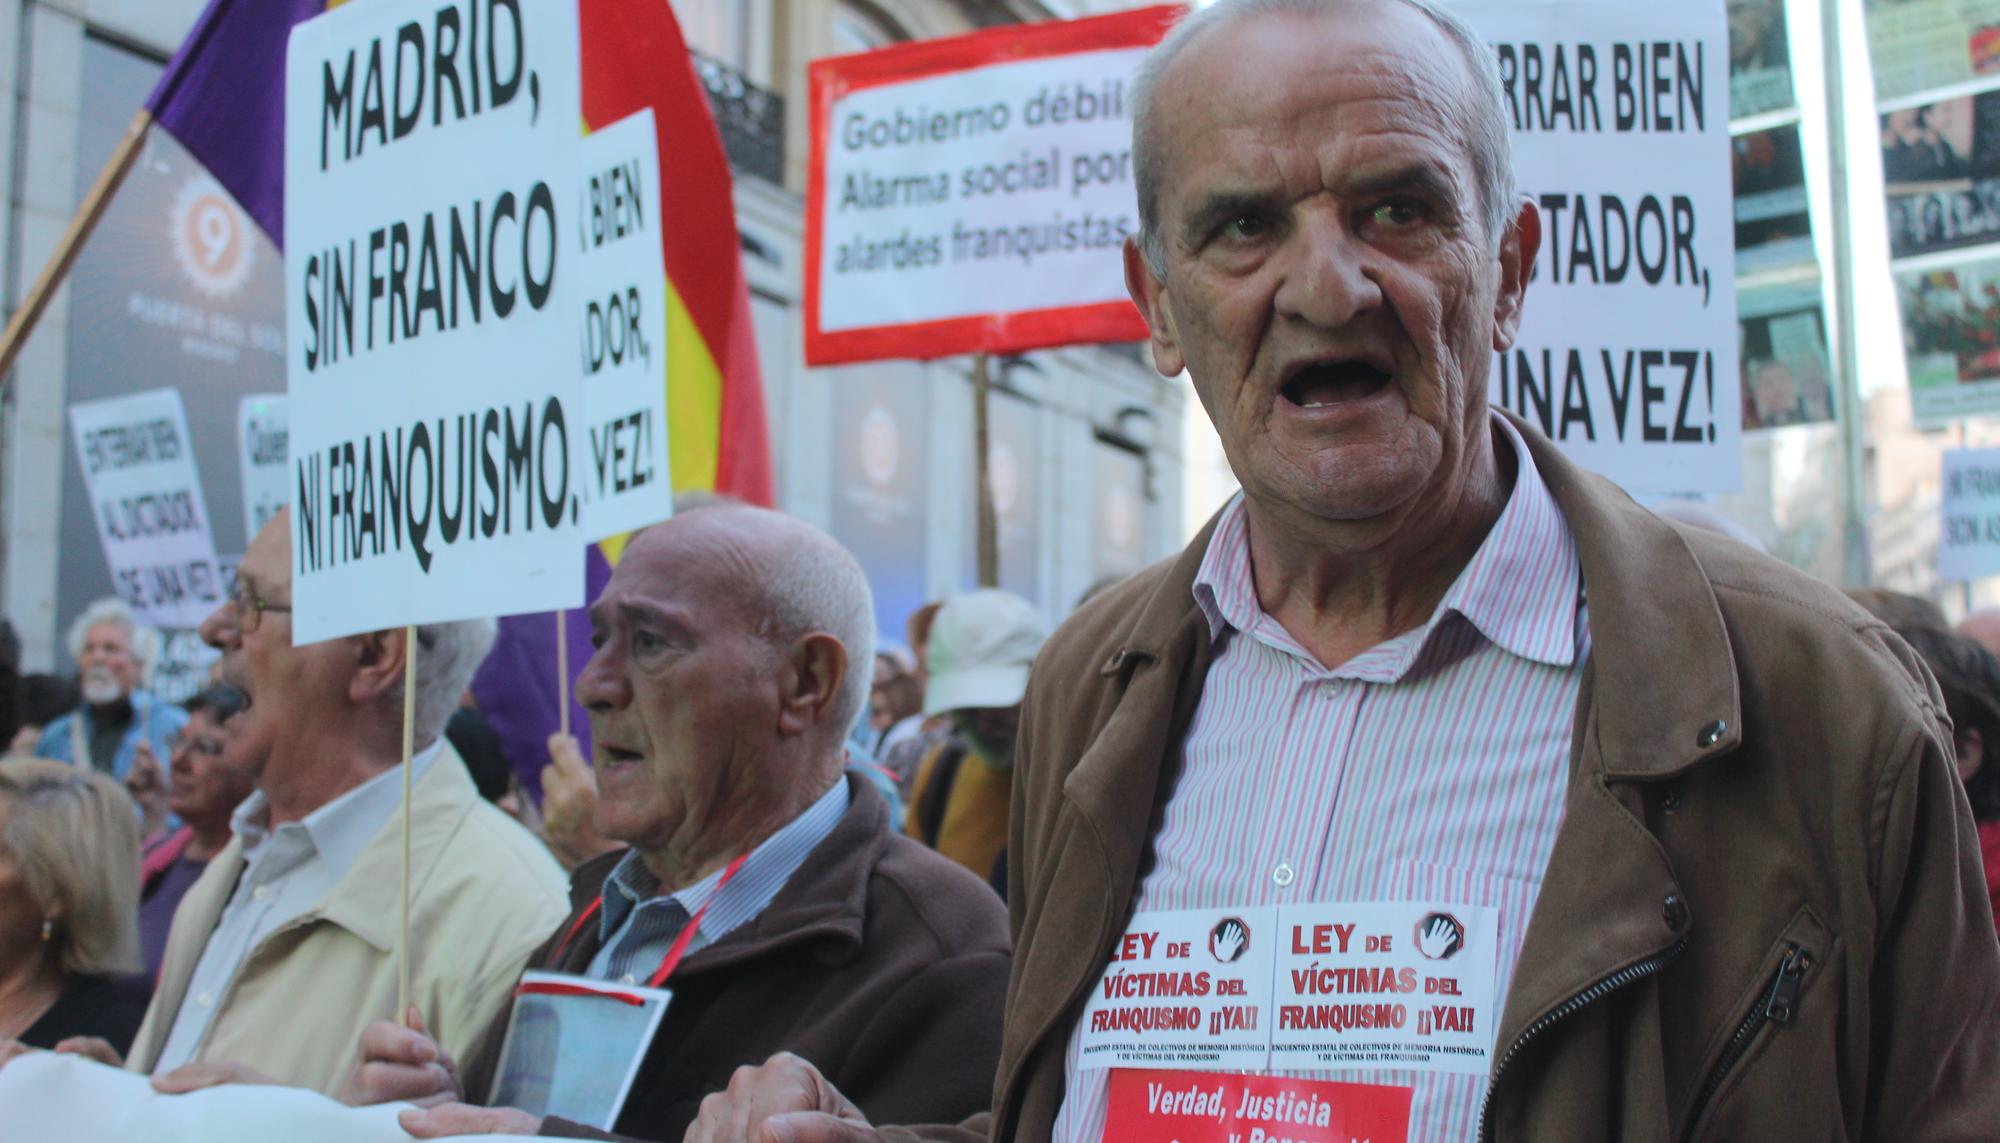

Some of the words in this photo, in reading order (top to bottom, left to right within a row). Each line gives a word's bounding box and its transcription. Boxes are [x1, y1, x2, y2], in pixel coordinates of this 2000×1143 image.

[320, 0, 540, 172] MADRID,
[842, 101, 1010, 151] Gobierno
[1024, 79, 1123, 127] débil
[1498, 43, 1603, 132] RRAR
[1612, 41, 1705, 132] BIEN
[589, 156, 645, 247] BIEN
[838, 166, 950, 210] Alarma
[961, 147, 1060, 198] social
[1072, 150, 1131, 198] por
[834, 226, 943, 274] alardes
[952, 214, 1132, 267] franquistas
[1529, 194, 1711, 308] TADOR,
[305, 239, 356, 373] SIN
[366, 180, 557, 351] FRANCO
[583, 285, 650, 376] DOR,
[1600, 347, 1716, 444] VEZ!
[589, 408, 655, 499] VEZ!
[298, 449, 322, 576] NI
[329, 396, 578, 575] FRANQUISMO.
[1166, 942, 1191, 959] DE
[1291, 924, 1356, 955] LEY
[1365, 935, 1393, 952] DE
[1103, 967, 1212, 1000] VÍCTIMAS
[1216, 979, 1248, 996] DEL
[1291, 961, 1417, 995] VÍCTIMAS
[1424, 977, 1462, 996] DEL
[1091, 1006, 1201, 1035] FRANQUISMO
[1209, 1006, 1259, 1035] ¡¡YA!!
[1112, 1043, 1136, 1052] ESTATAL
[1138, 1043, 1147, 1052] DE
[1148, 1043, 1187, 1052] COLECTIVOS
[1188, 1043, 1197, 1052] DE
[1198, 1043, 1229, 1052] MEMORIA
[1272, 1044, 1310, 1052] ENCUENTRO
[1312, 1044, 1338, 1052] ESTATAL
[1340, 1043, 1348, 1052] DE
[1349, 1043, 1391, 1052] COLECTIVOS
[1392, 1044, 1401, 1052] DE
[1403, 1044, 1441, 1054] MEMORIA
[1443, 1044, 1485, 1057] HISTÓRICA
[1279, 1004, 1407, 1033] FRANQUISMO
[1417, 1005, 1475, 1036] ¡¡YA!!
[1164, 1053, 1176, 1061] DEL
[1177, 1053, 1220, 1062] FRANQUISMO
[1323, 1053, 1331, 1061] DE
[1366, 1053, 1379, 1062] DEL
[1380, 1053, 1430, 1063] FRANQUISMO
[1148, 1082, 1227, 1124] Verdad,
[1236, 1087, 1331, 1127] Justicia
